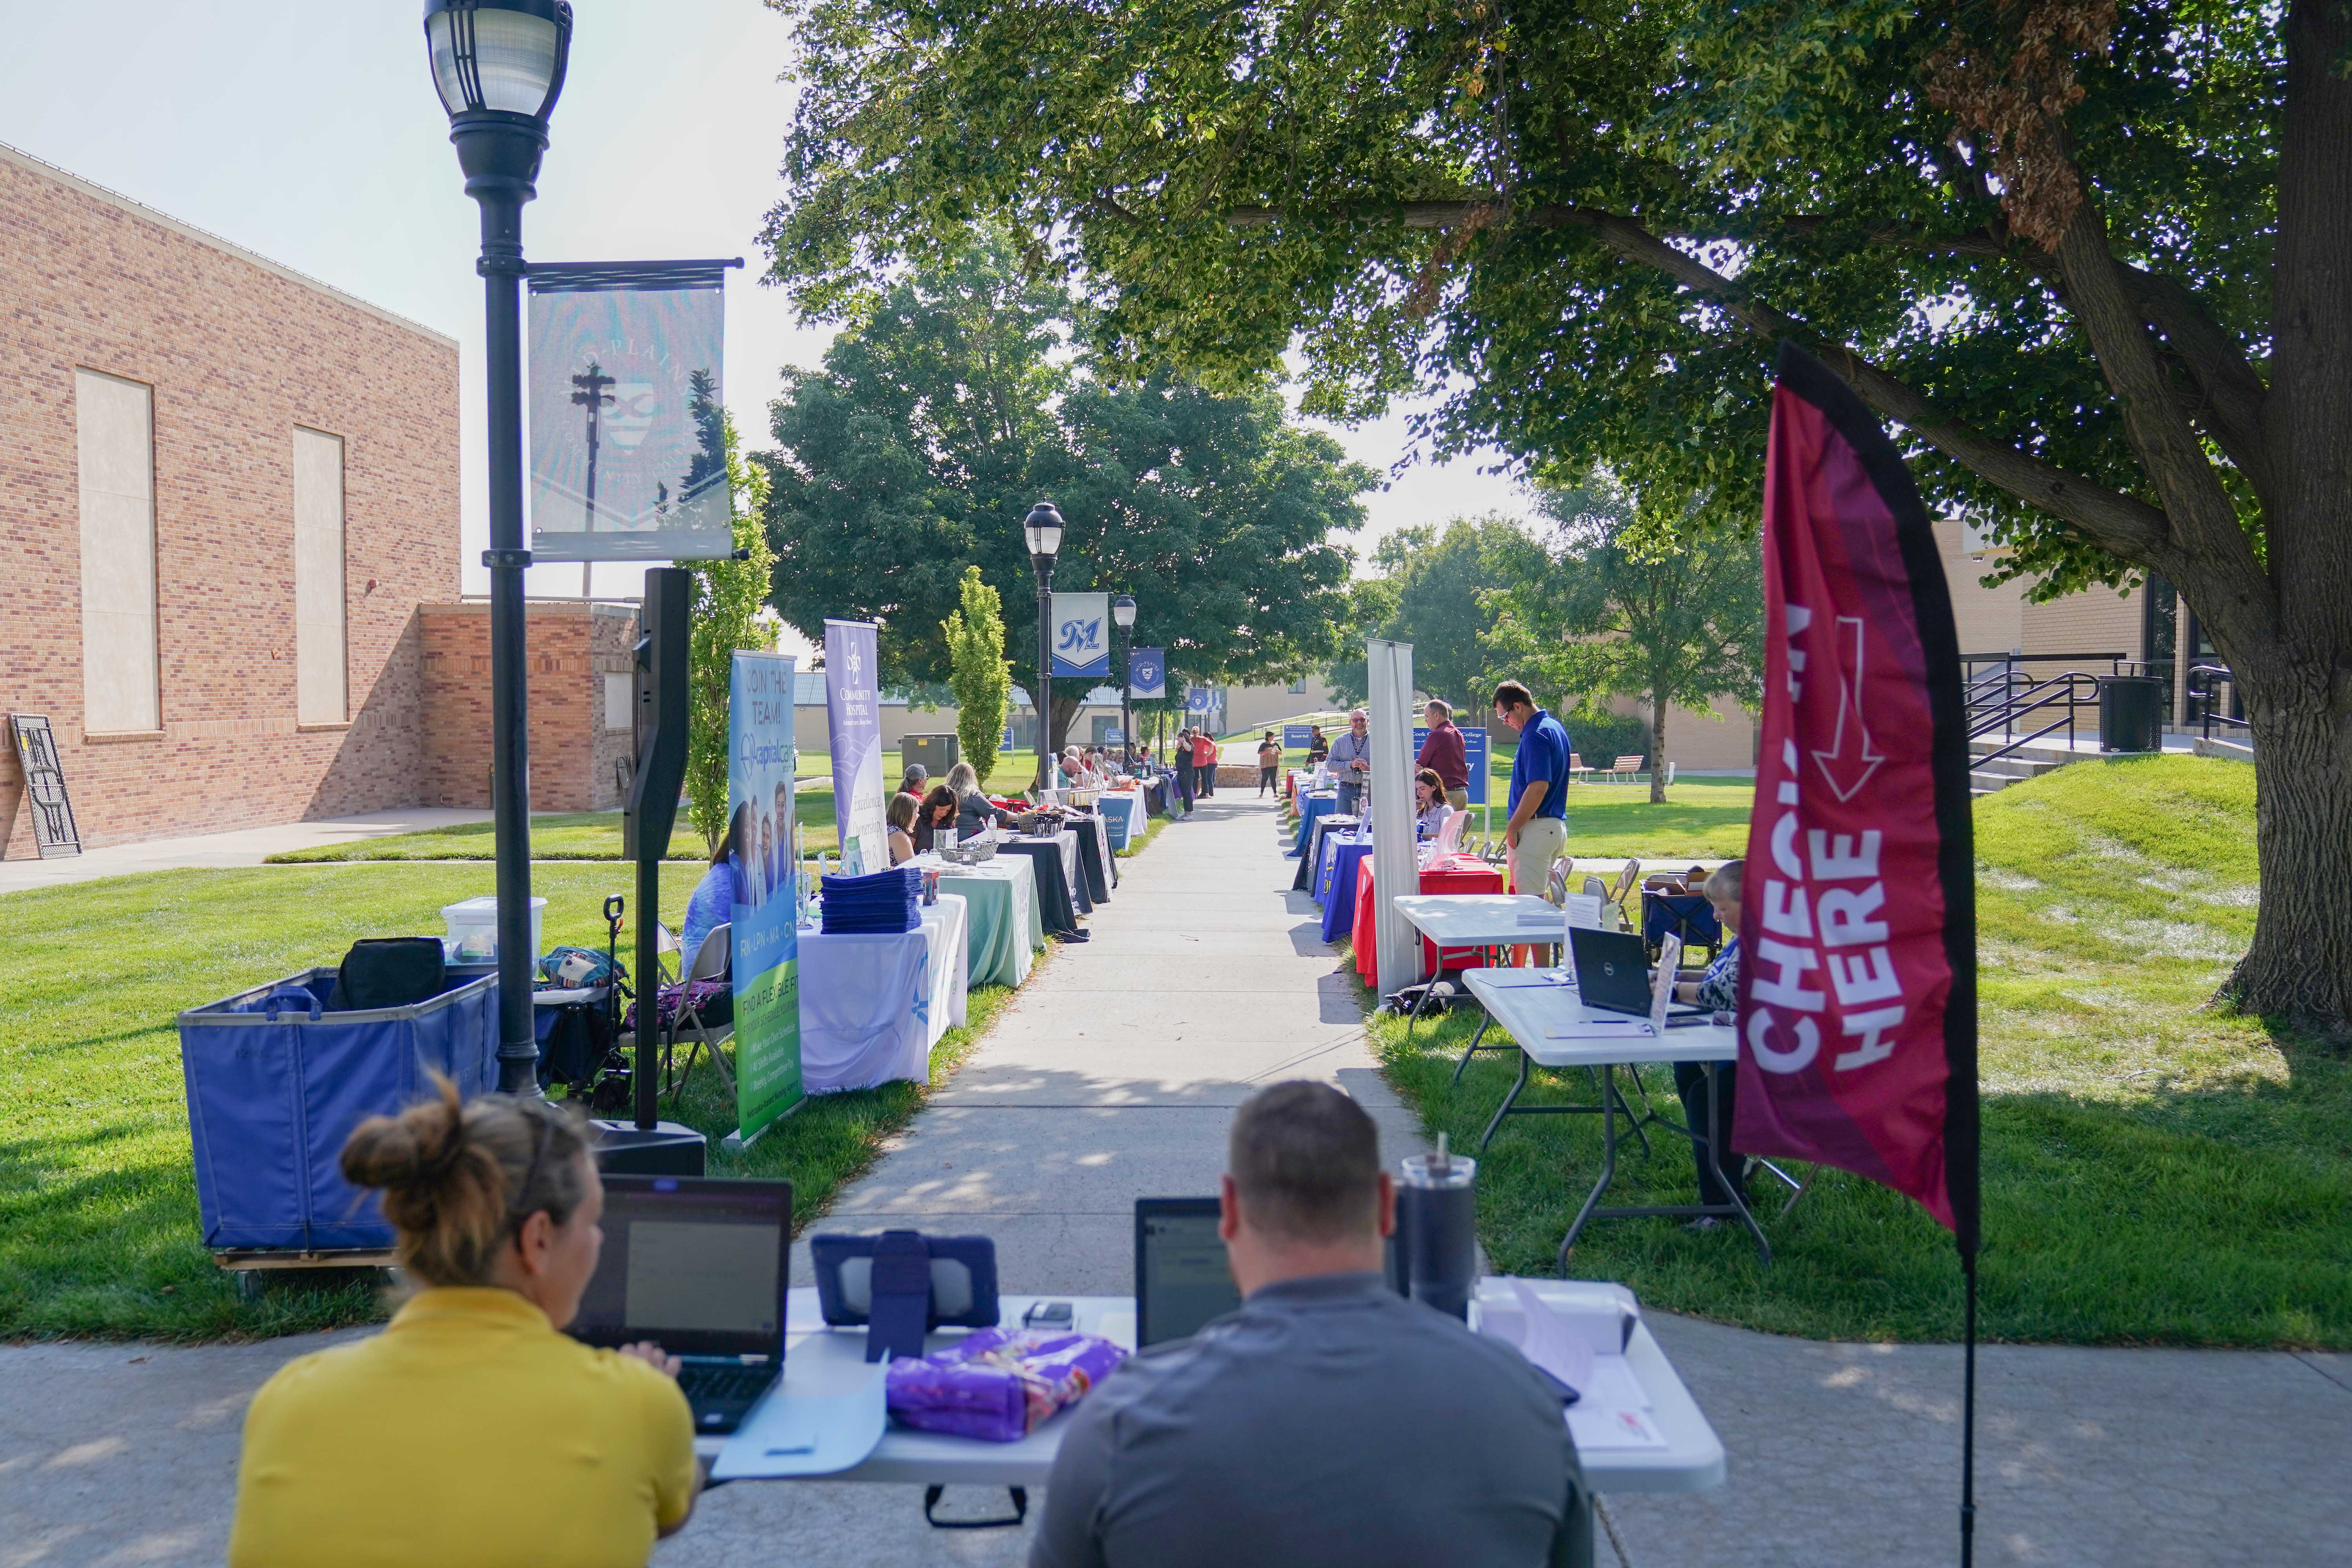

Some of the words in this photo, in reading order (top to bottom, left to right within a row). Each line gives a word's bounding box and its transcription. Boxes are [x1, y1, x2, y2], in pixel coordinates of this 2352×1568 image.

[1058, 617, 1102, 653] M
[746, 669, 767, 693] JOIN
[769, 671, 787, 694] THE
[752, 701, 781, 725] TEAM!
[854, 793, 883, 811] Excellence,
[853, 818, 882, 838] Ownership,
[740, 937, 751, 958] RN
[753, 930, 765, 951] LPN
[770, 925, 779, 945] MA
[784, 919, 796, 938] CN
[1807, 829, 1906, 1073] HERE
[743, 995, 755, 1016] FIND
[757, 993, 762, 1008] A
[762, 979, 789, 1005] FLEXIBLE
